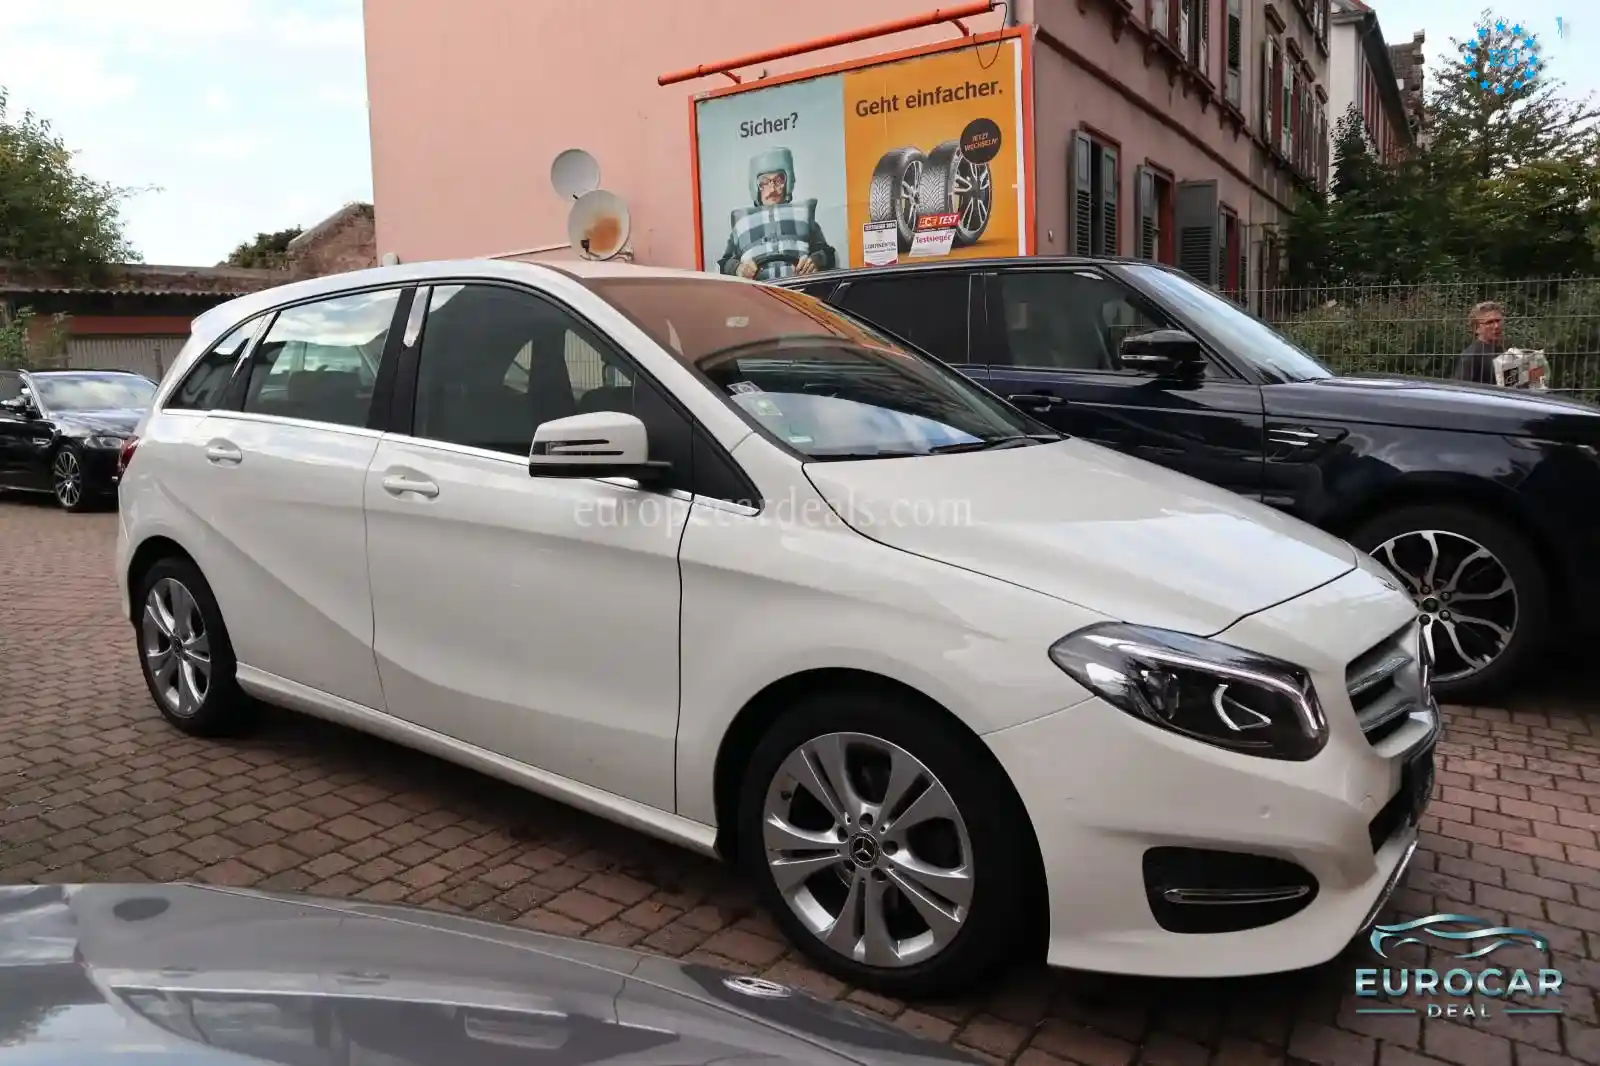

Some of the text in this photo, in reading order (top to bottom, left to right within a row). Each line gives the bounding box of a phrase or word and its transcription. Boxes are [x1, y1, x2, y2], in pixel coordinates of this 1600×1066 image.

[856, 80, 1004, 118] Geht einfacher.
[740, 112, 799, 138] Sicher?
[938, 214, 959, 224] TEST
